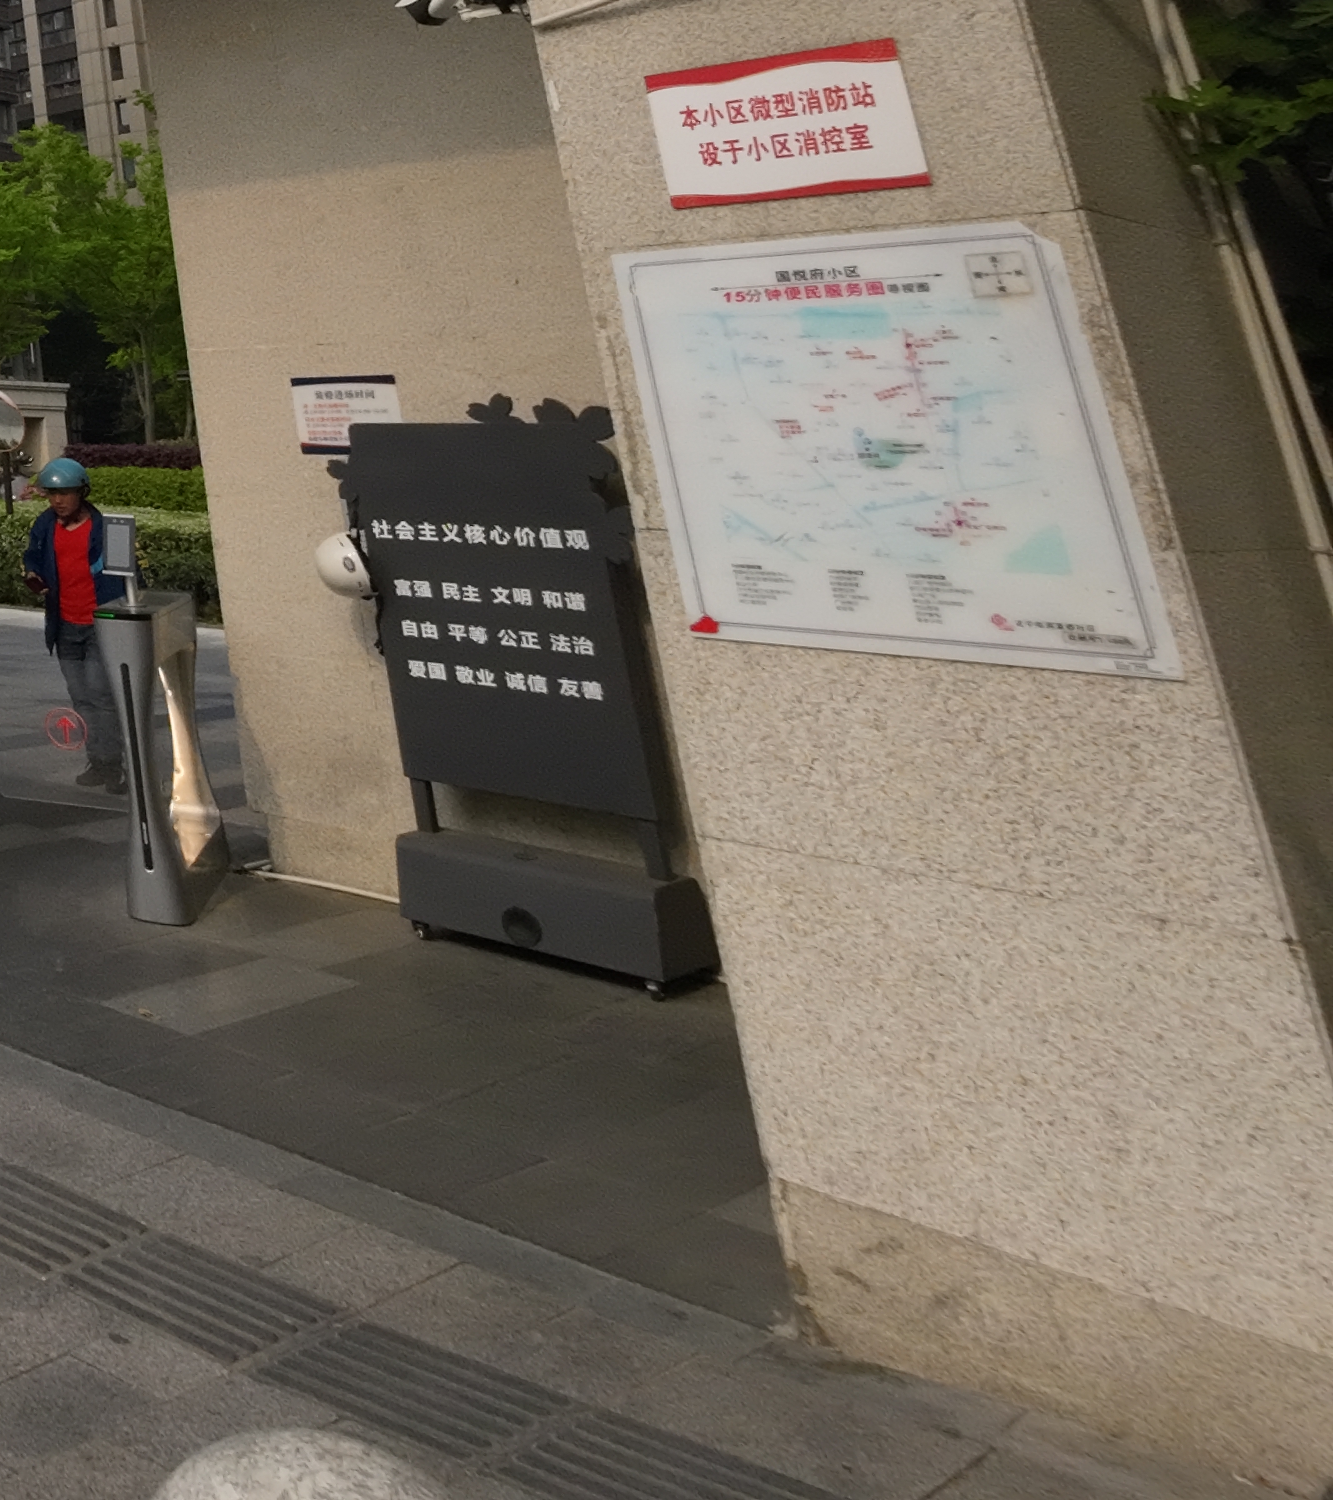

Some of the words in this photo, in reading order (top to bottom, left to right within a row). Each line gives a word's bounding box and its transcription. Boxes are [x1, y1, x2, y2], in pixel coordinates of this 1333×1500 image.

[679, 81, 877, 131] 本小区微型消防站
[698, 122, 875, 167] 设于小区消控室
[775, 265, 861, 283] 国悦府小区
[371, 519, 590, 551] 社会主义核心价值观
[393, 579, 433, 598] 富强
[441, 582, 482, 603] 民主
[490, 586, 532, 606] 文明
[541, 590, 587, 612] 和谐
[401, 619, 439, 640] 自由
[447, 623, 488, 645] 平等
[497, 628, 541, 650] 公正
[550, 633, 595, 656] 法治
[408, 660, 447, 681] 爱国
[455, 665, 497, 688] 敬业
[505, 671, 549, 694] 诚信
[558, 677, 604, 701] 友善
